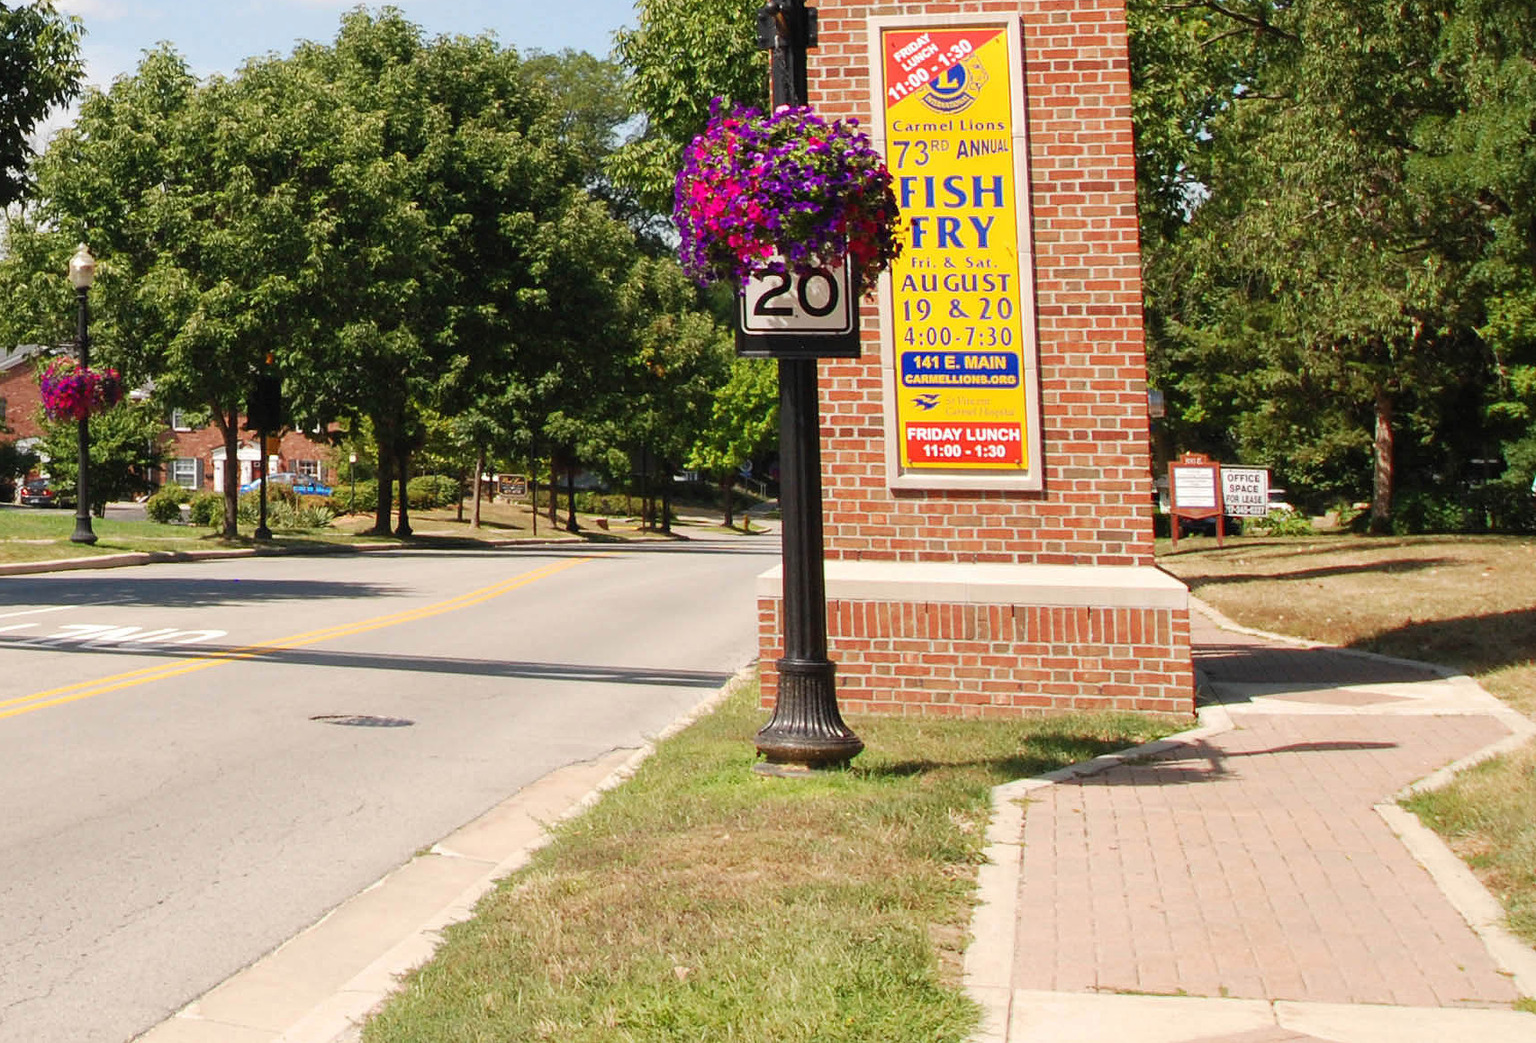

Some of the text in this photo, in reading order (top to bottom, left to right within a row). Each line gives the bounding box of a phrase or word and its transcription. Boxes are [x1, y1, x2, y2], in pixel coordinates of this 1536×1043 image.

[893, 32, 931, 63] FRIDAY
[901, 42, 939, 72] LUNCH
[888, 68, 930, 100] 11:00
[938, 39, 973, 67] 1:30
[892, 119, 1006, 132] Carmel Lions
[956, 139, 1009, 159] ANNUAL
[899, 175, 1004, 209] FISH
[911, 215, 995, 249] FRY
[911, 256, 998, 269] Fri. & Sat.
[901, 273, 1011, 293] AUGUST
[753, 268, 839, 317] 20
[903, 297, 1013, 322] 19 & 20
[913, 355, 1007, 369] 141 E. MAIN
[904, 374, 1017, 385] CARMELLIONS.ORG
[907, 427, 1021, 442] FRIDAY LUNCH
[923, 444, 962, 458] 11:00
[975, 445, 1006, 458] 1:30
[1227, 474, 1260, 483] OFFICE
[1230, 485, 1258, 493] SPACE
[1226, 495, 1262, 504] FOR LEASE
